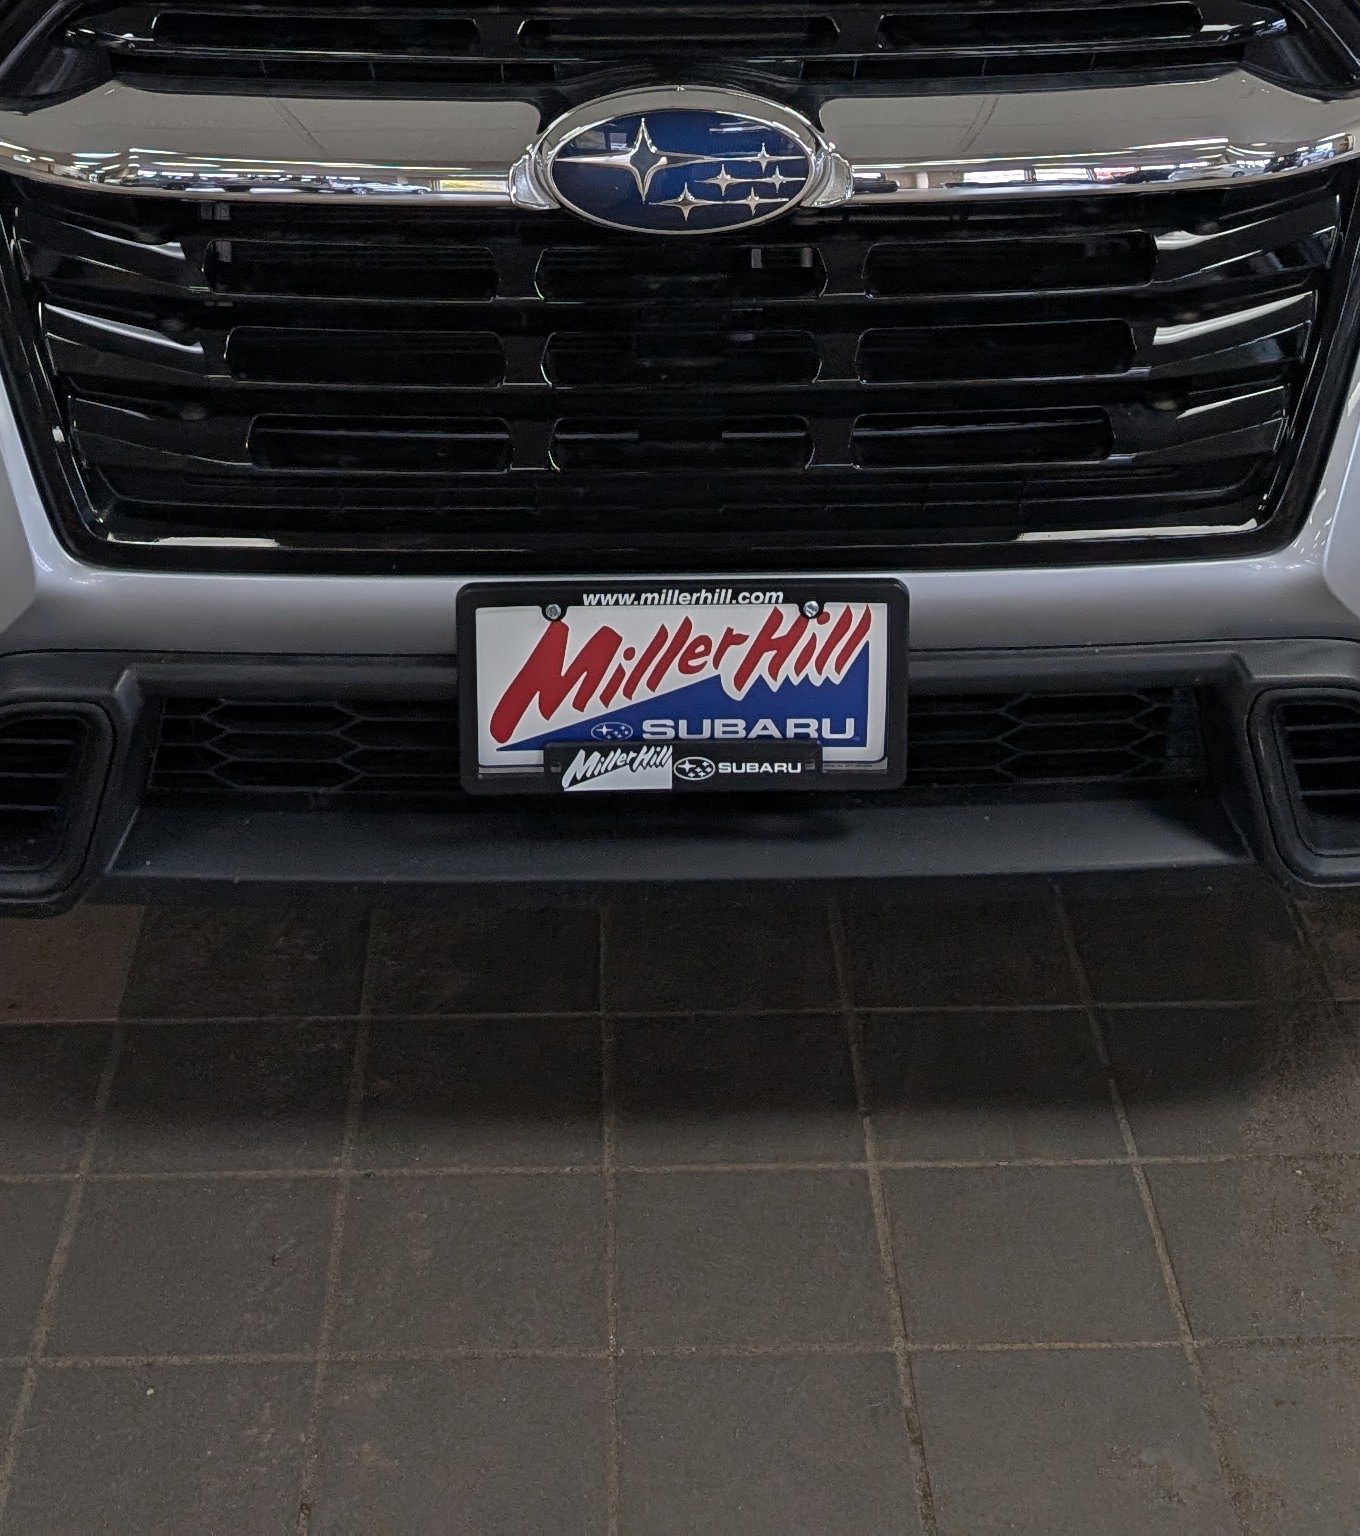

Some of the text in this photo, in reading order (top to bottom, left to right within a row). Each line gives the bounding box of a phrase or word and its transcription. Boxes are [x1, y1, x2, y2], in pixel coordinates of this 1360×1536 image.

[582, 588, 784, 605] www.millerhill.com
[642, 717, 855, 740] SUBARU
[717, 761, 802, 774] SUBARU
